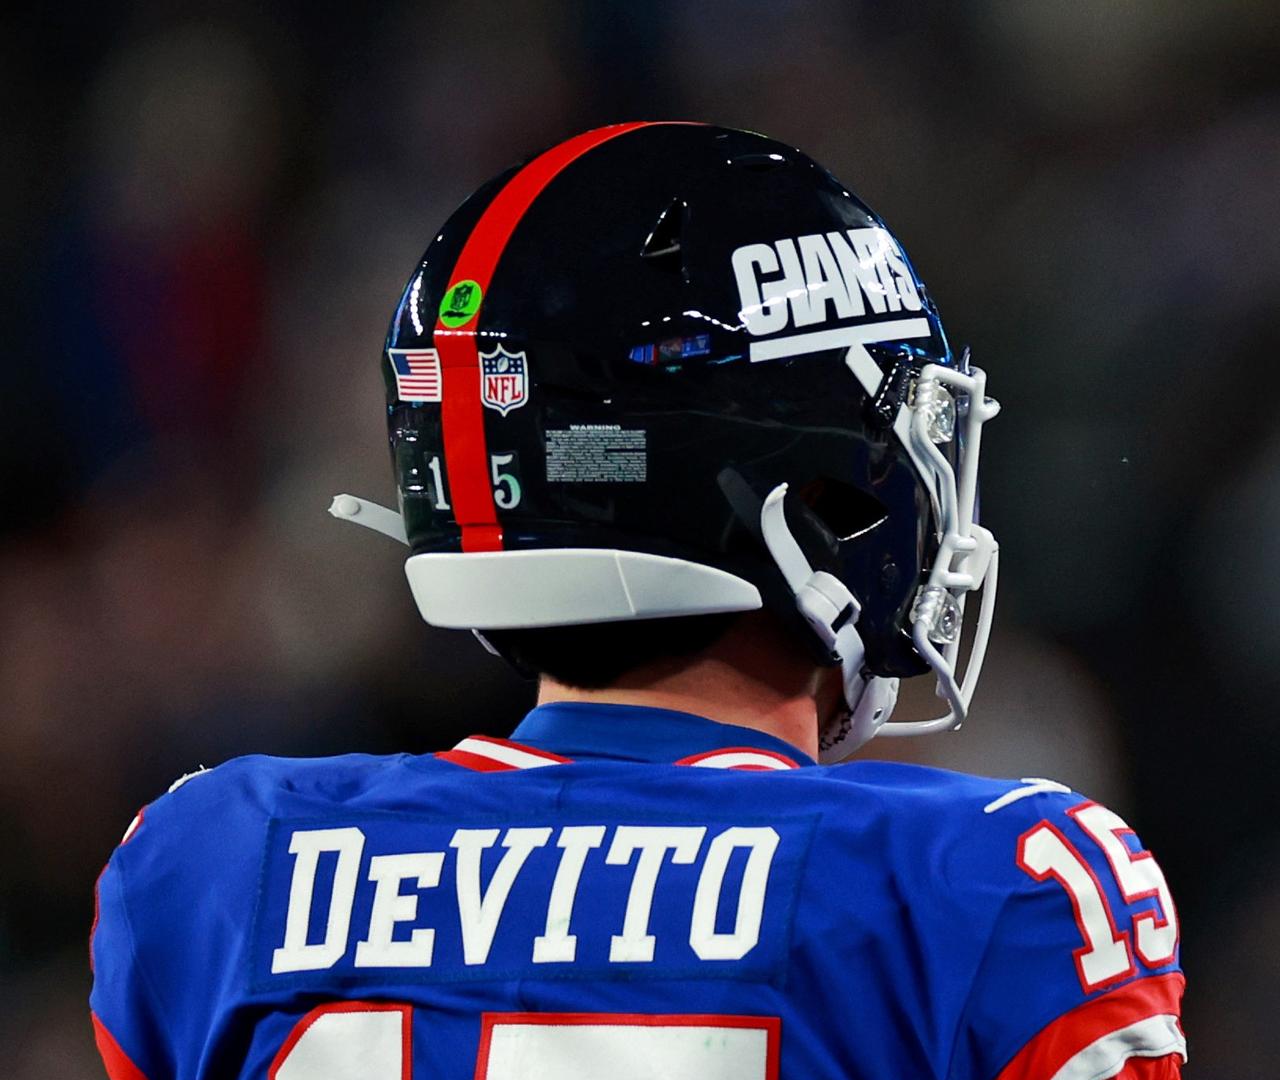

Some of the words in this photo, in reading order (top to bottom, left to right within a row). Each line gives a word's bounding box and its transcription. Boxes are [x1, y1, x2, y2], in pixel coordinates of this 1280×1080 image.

[731, 227, 923, 336] GIANTS
[486, 376, 521, 403] NFL
[271, 826, 780, 974] DeVITO
[1015, 799, 1180, 995] 15
